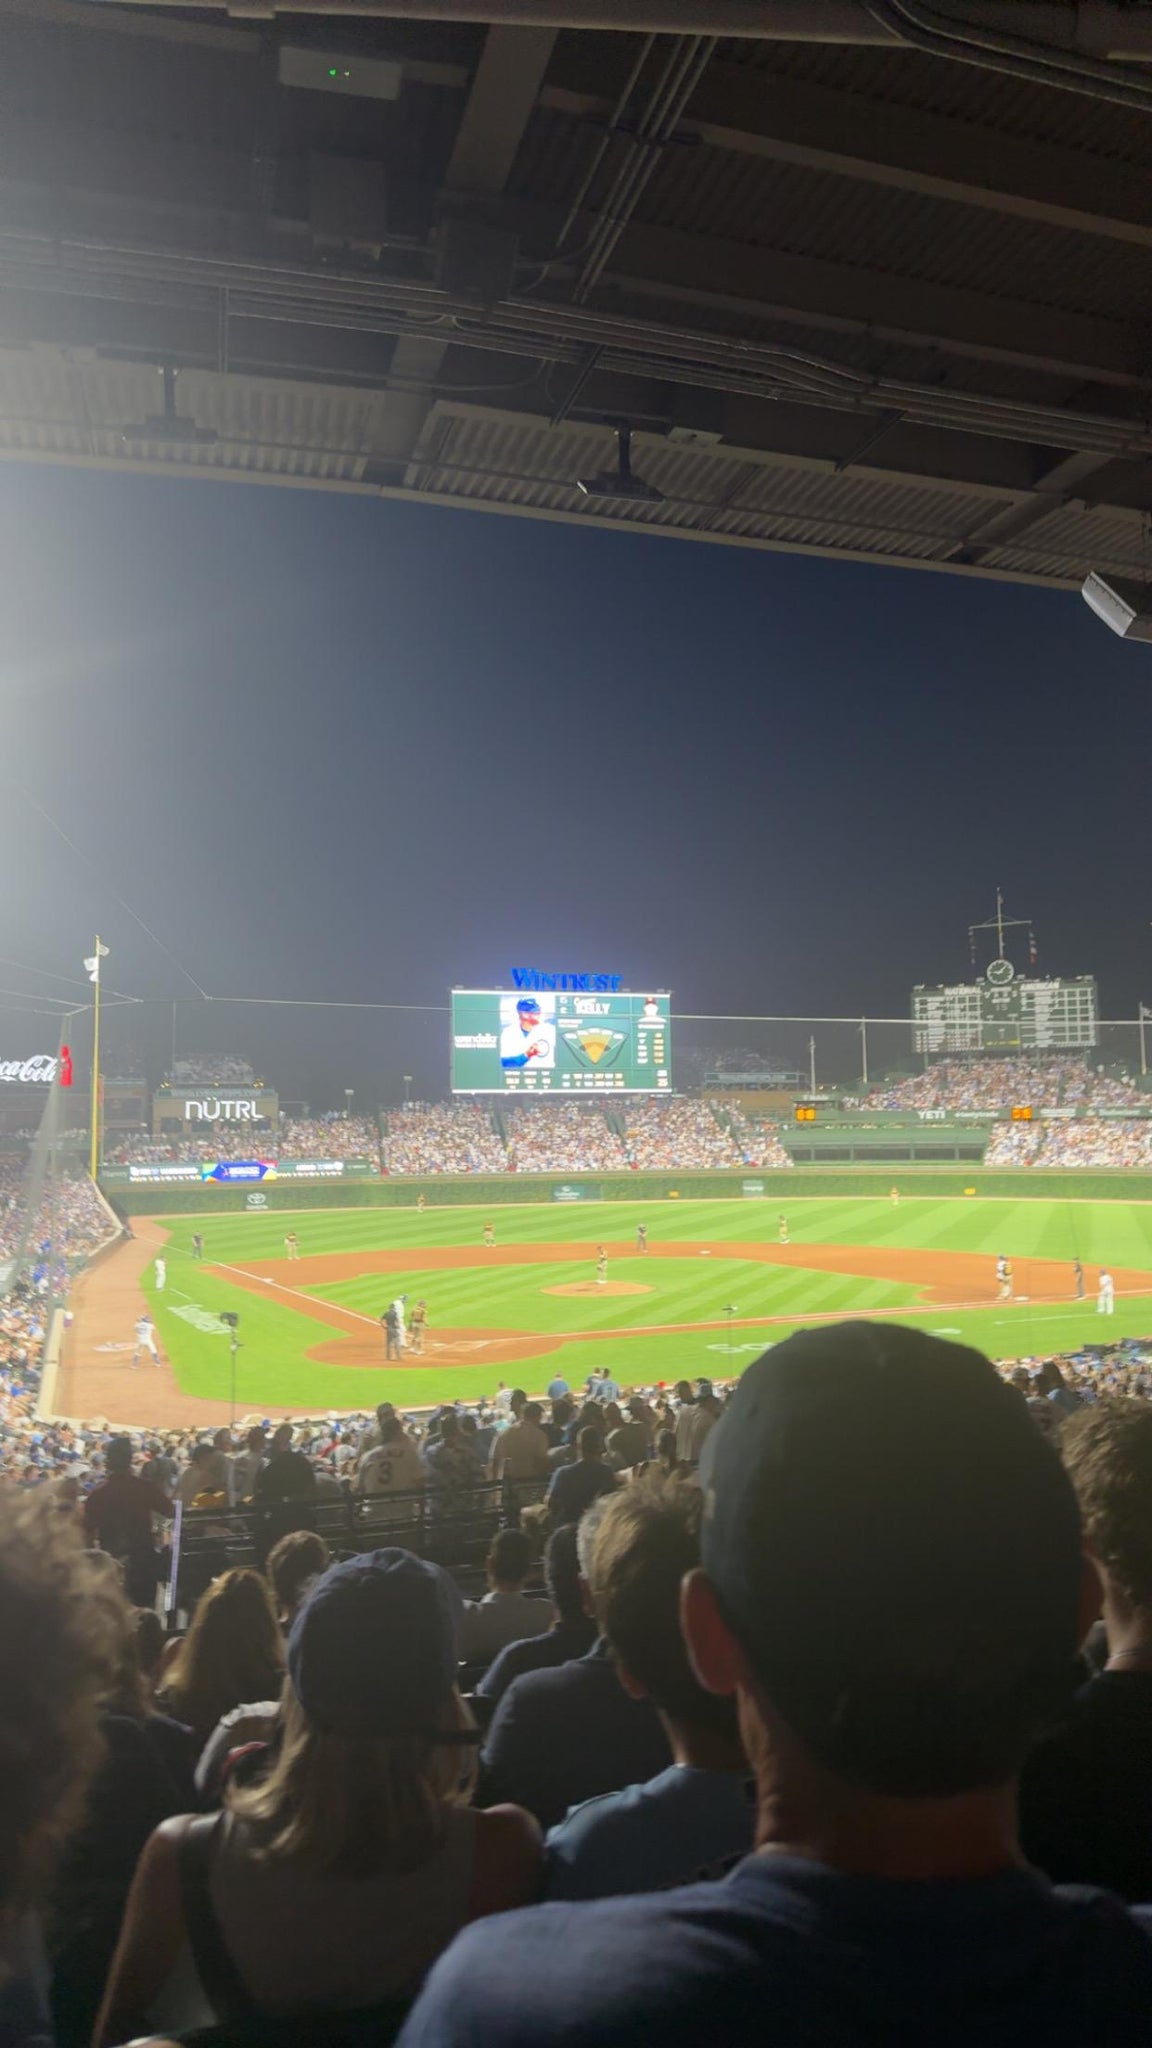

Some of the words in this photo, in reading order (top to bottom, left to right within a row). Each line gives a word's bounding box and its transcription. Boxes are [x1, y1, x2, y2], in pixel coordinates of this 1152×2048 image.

[576, 1003, 611, 1015] KELLY
[917, 1109, 946, 1119] YETI
[378, 1461, 392, 1484] 3
